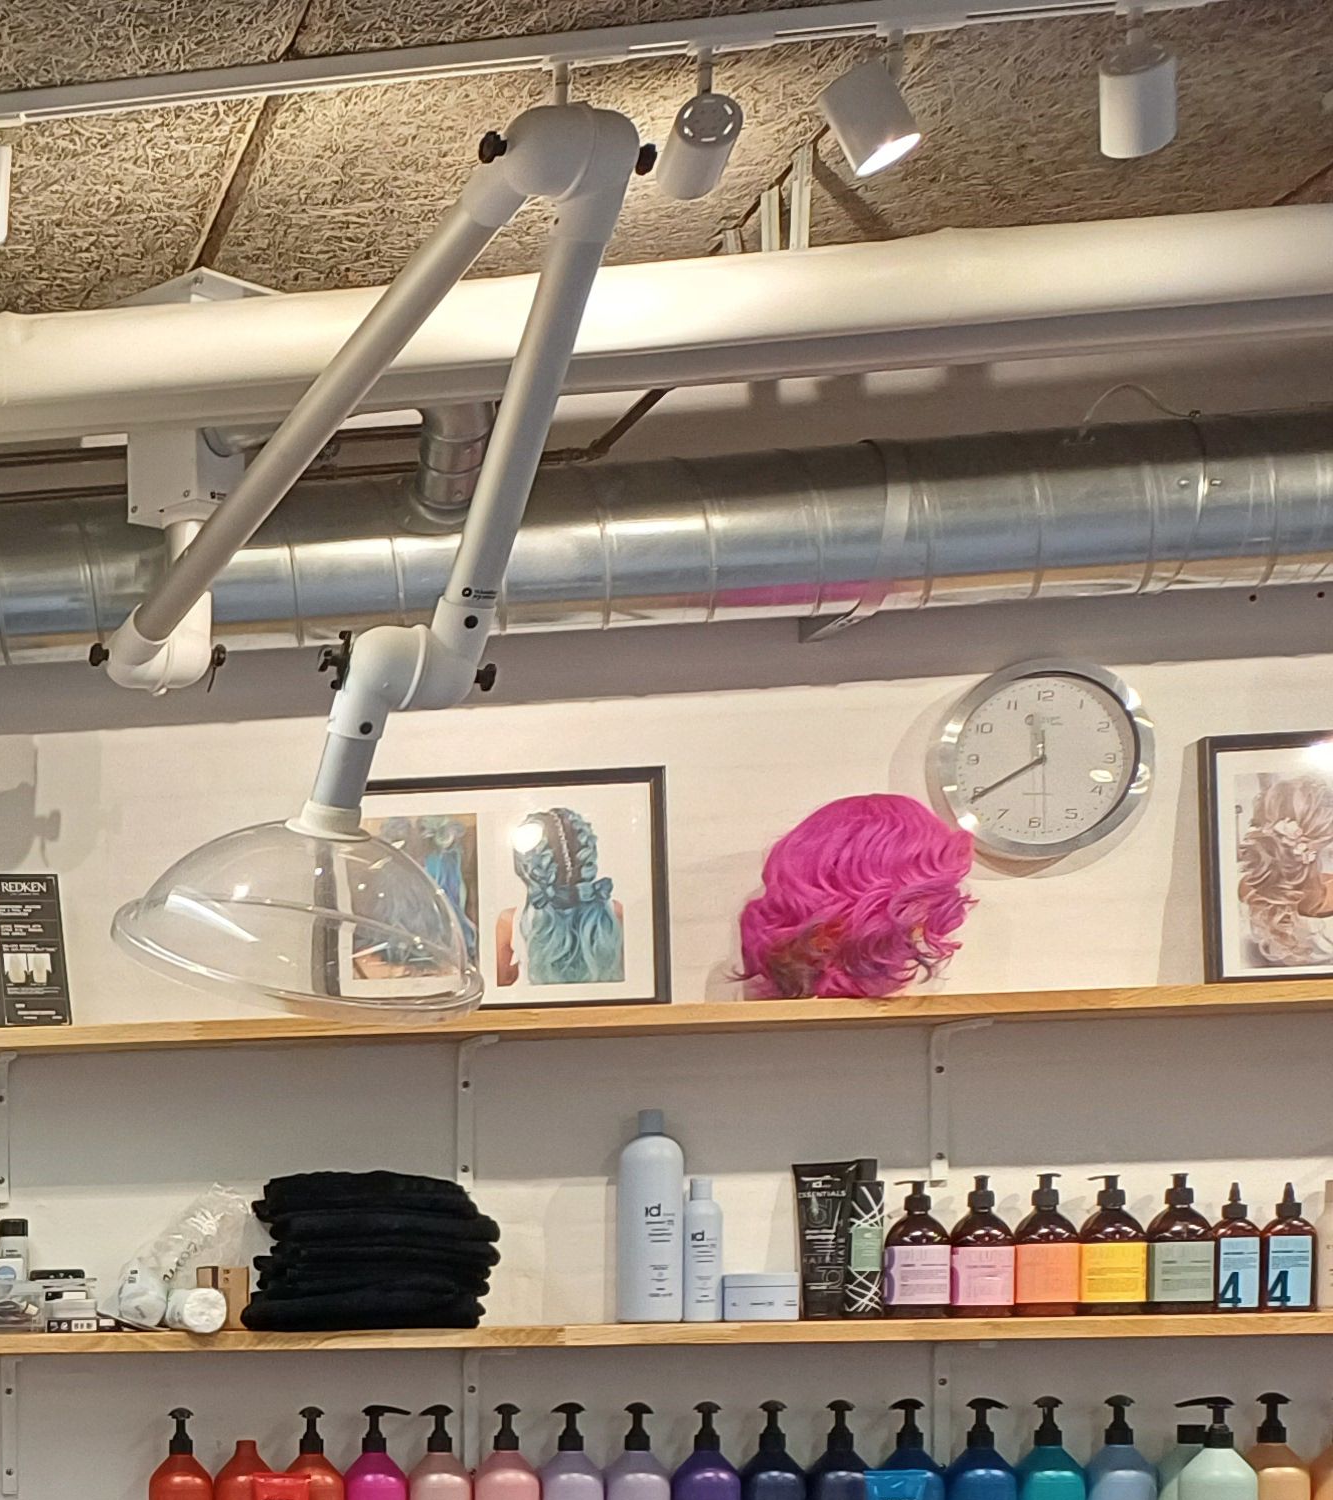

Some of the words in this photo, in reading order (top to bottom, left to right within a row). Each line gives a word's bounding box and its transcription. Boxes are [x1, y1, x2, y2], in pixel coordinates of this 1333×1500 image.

[1037, 690, 1055, 702] 12
[1007, 700, 1018, 711] 11
[975, 723, 993, 735] 10
[1097, 721, 1110, 733] 2
[1104, 753, 1117, 764] 3
[1090, 785, 1103, 796] 4
[997, 808, 1010, 820] 7
[1065, 808, 1078, 820] 5
[1028, 817, 1042, 829] 6
[1, 881, 47, 893] REDKEN
[798, 1190, 847, 1199] ESSENTIALS
[1220, 1271, 1242, 1308] 4
[1268, 1270, 1292, 1307] 4
